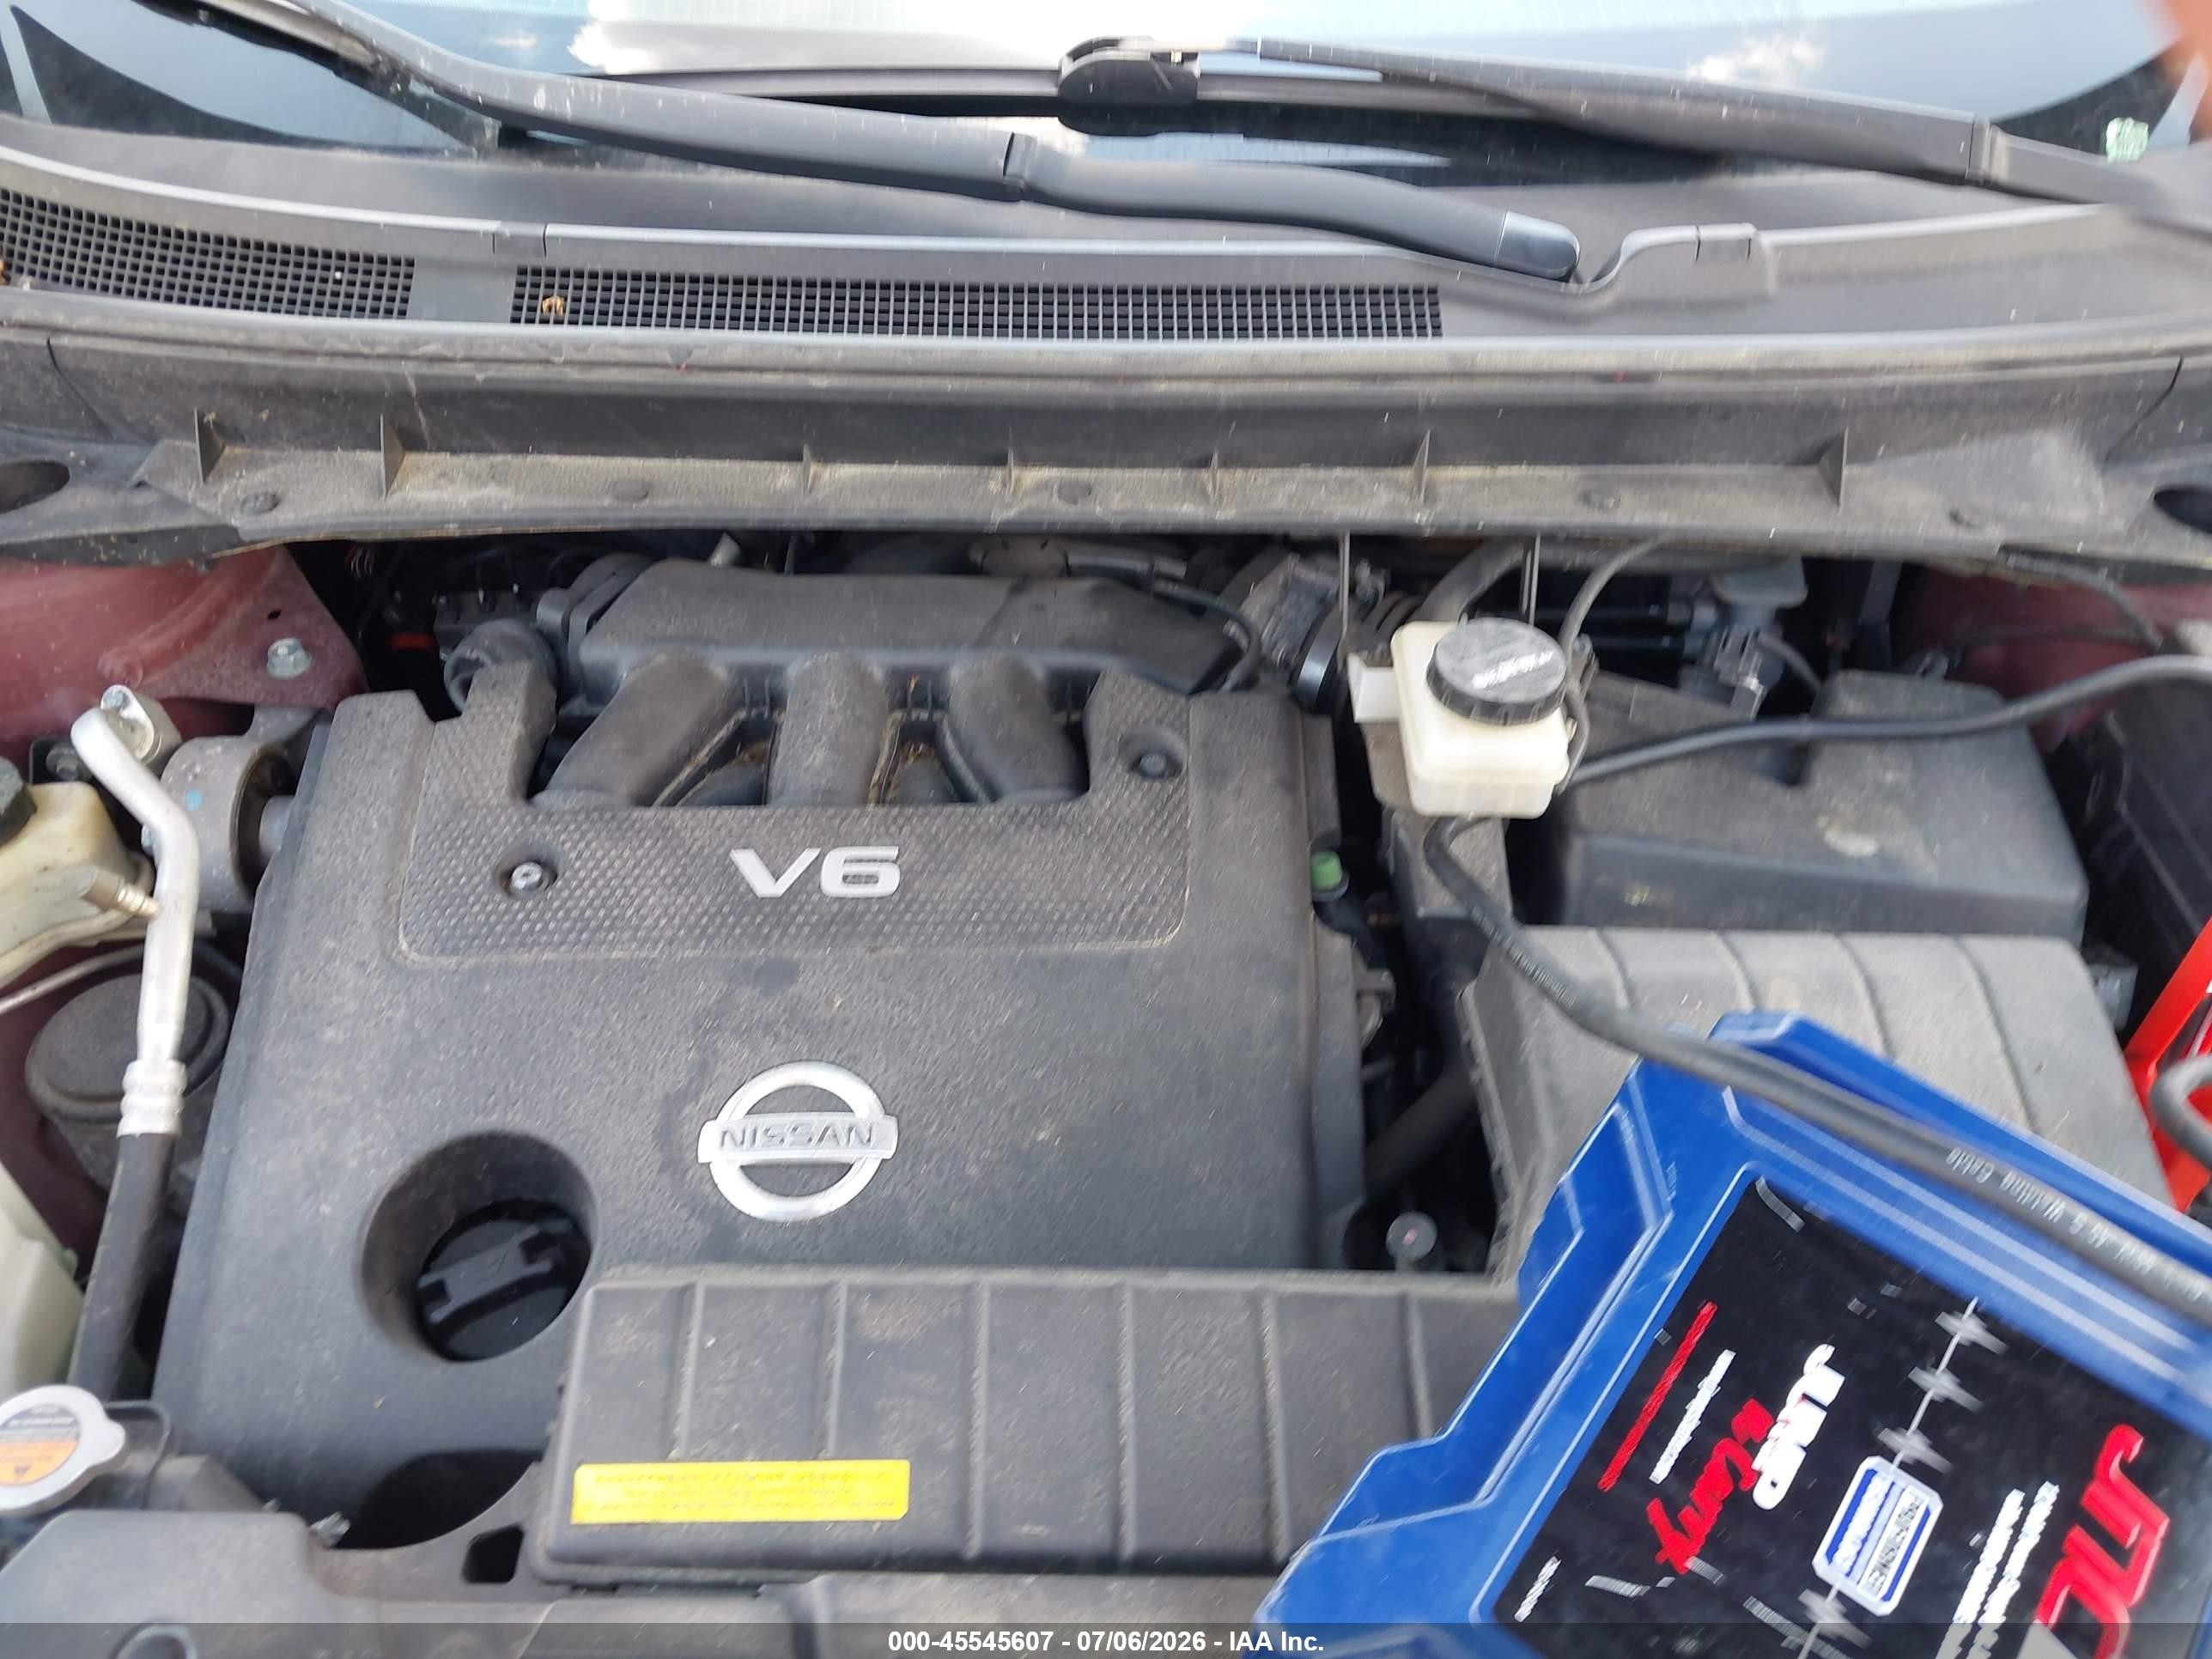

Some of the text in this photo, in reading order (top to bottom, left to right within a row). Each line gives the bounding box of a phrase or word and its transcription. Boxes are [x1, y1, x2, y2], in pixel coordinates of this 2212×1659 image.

[730, 845, 900, 898] V6
[720, 1118, 876, 1149] NISSAN
[1751, 1343, 1845, 1510] JUMP
